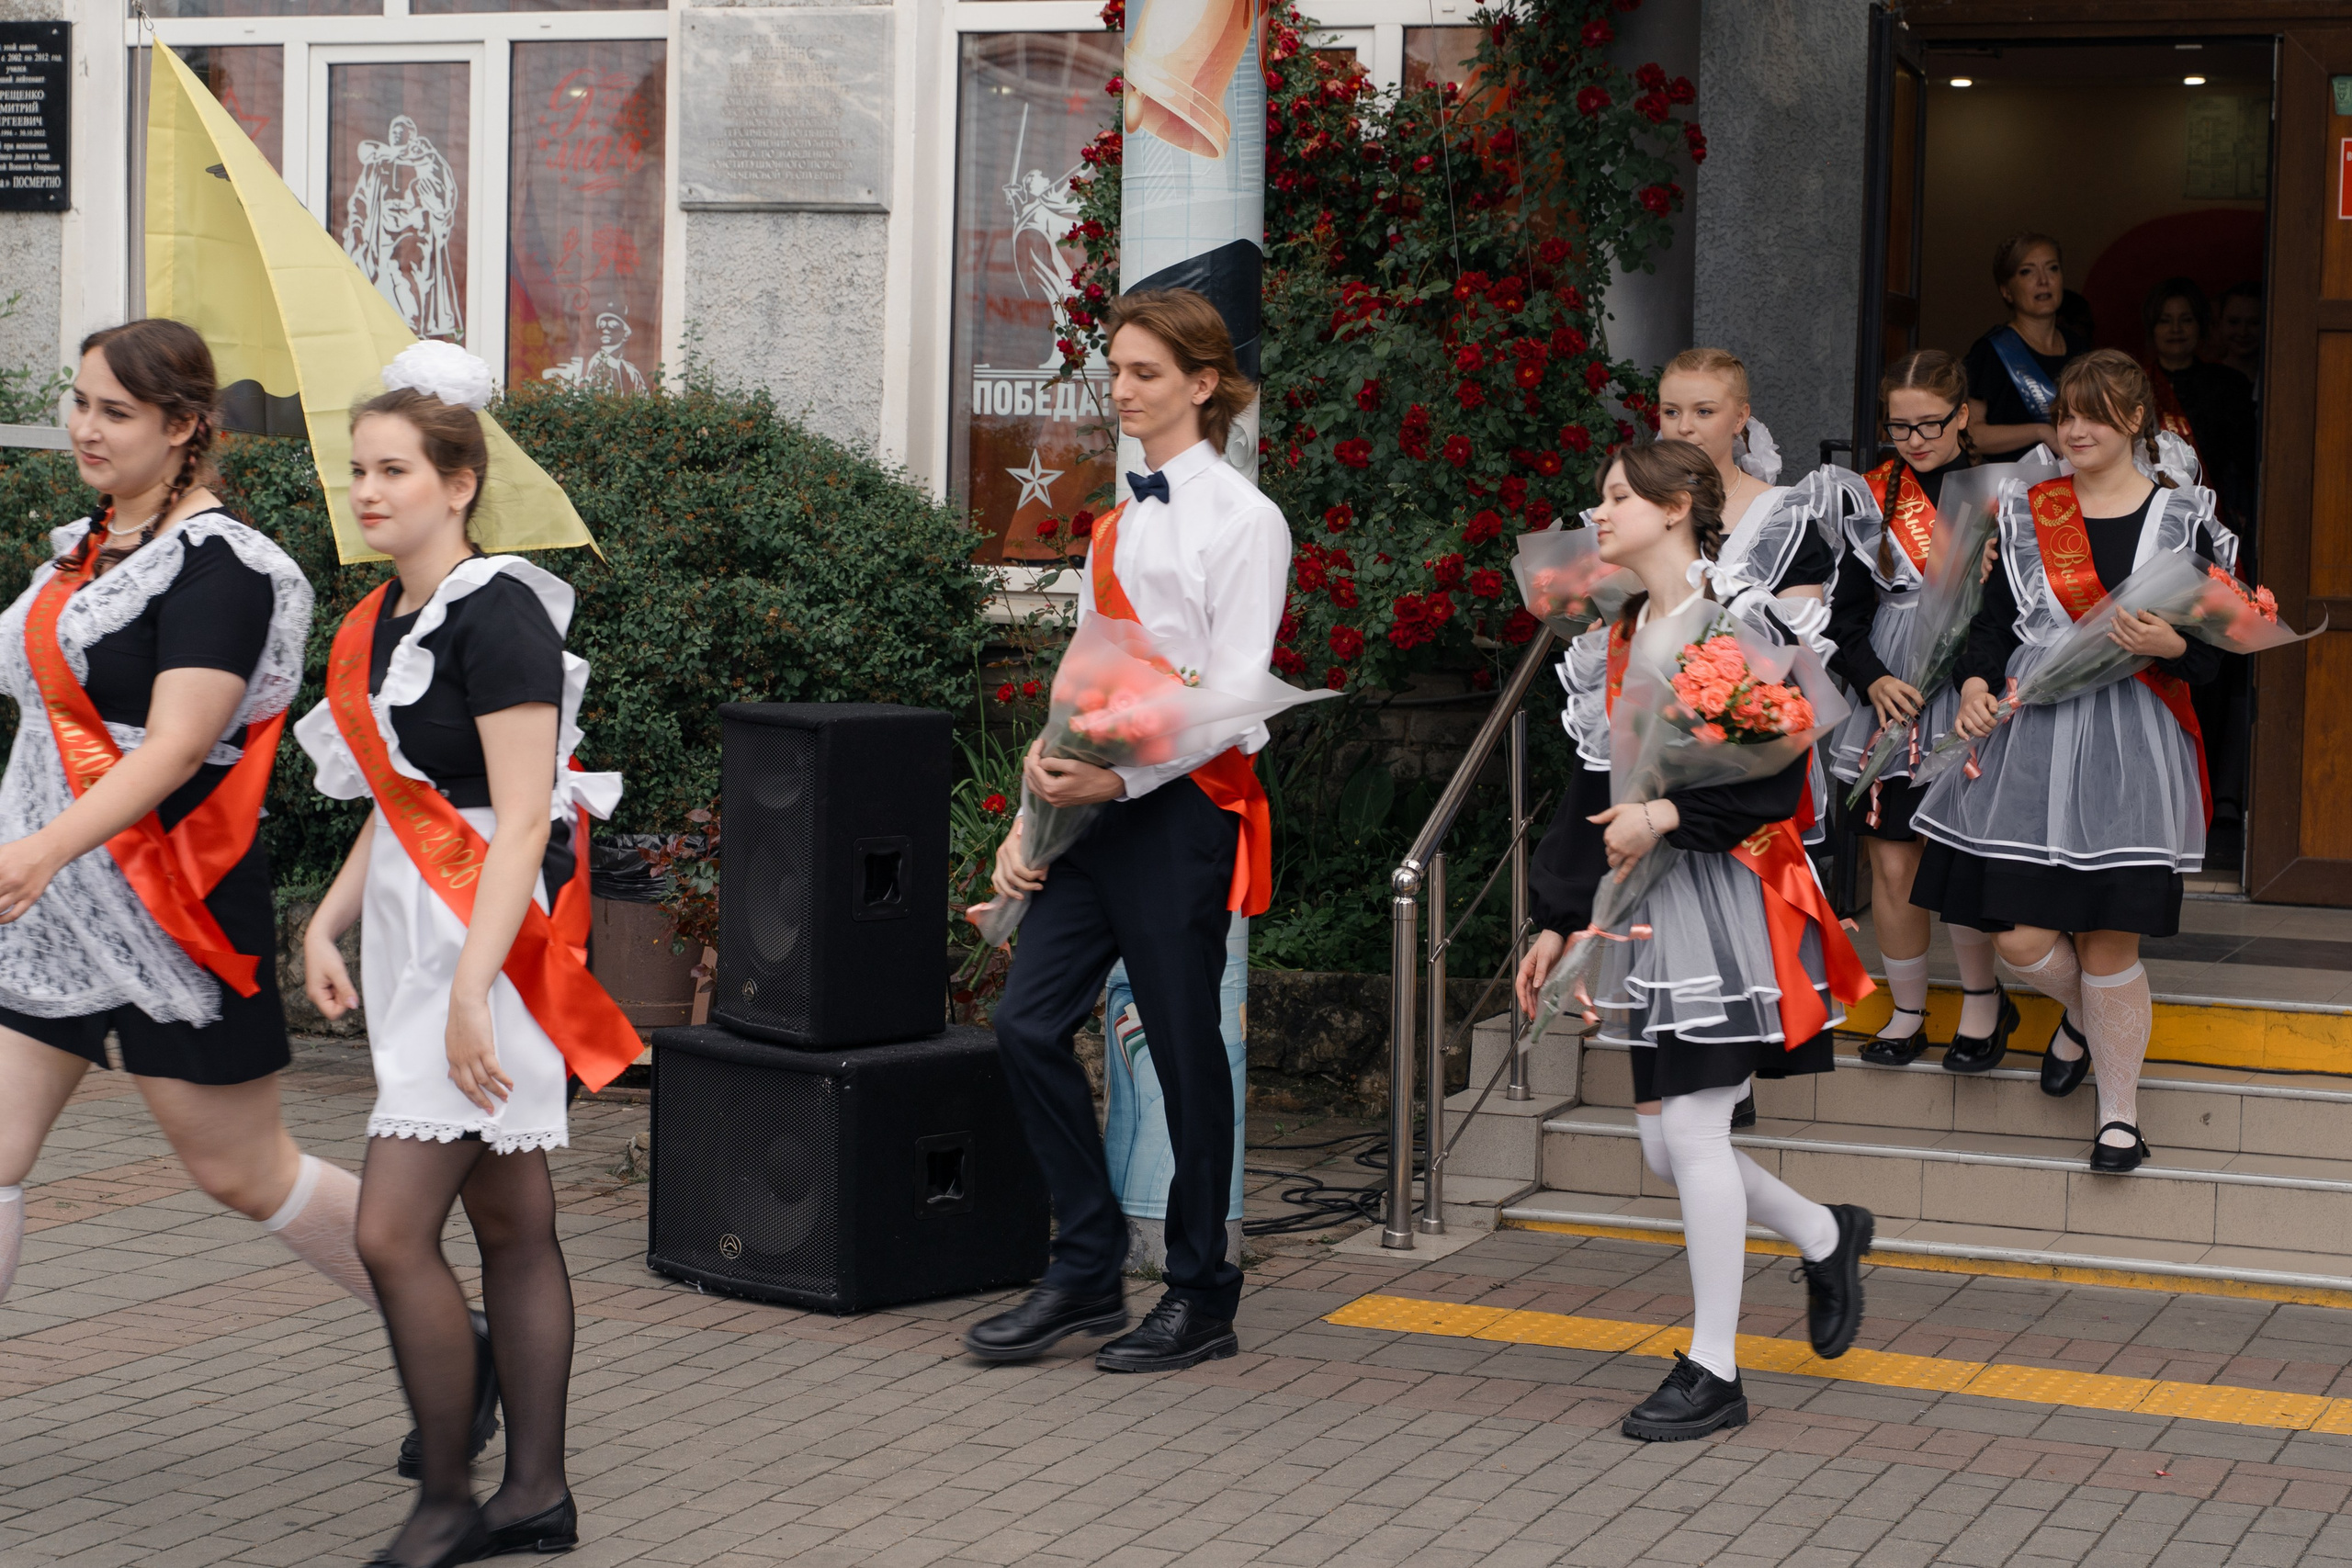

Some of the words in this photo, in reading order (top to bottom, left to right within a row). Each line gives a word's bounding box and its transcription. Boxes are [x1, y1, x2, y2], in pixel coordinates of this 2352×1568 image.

[0, 89, 45, 101] РЕЩЕНКО
[0, 100, 39, 113] МИТРИЙ
[0, 116, 43, 127] РГЕЕВИЧ
[13, 175, 62, 189] ПОСМЕРТНО
[973, 379, 1111, 423] ПОБЕДА!
[1895, 476, 1932, 559] Выпу
[2050, 525, 2093, 614] Выпу
[419, 826, 484, 889] 2026
